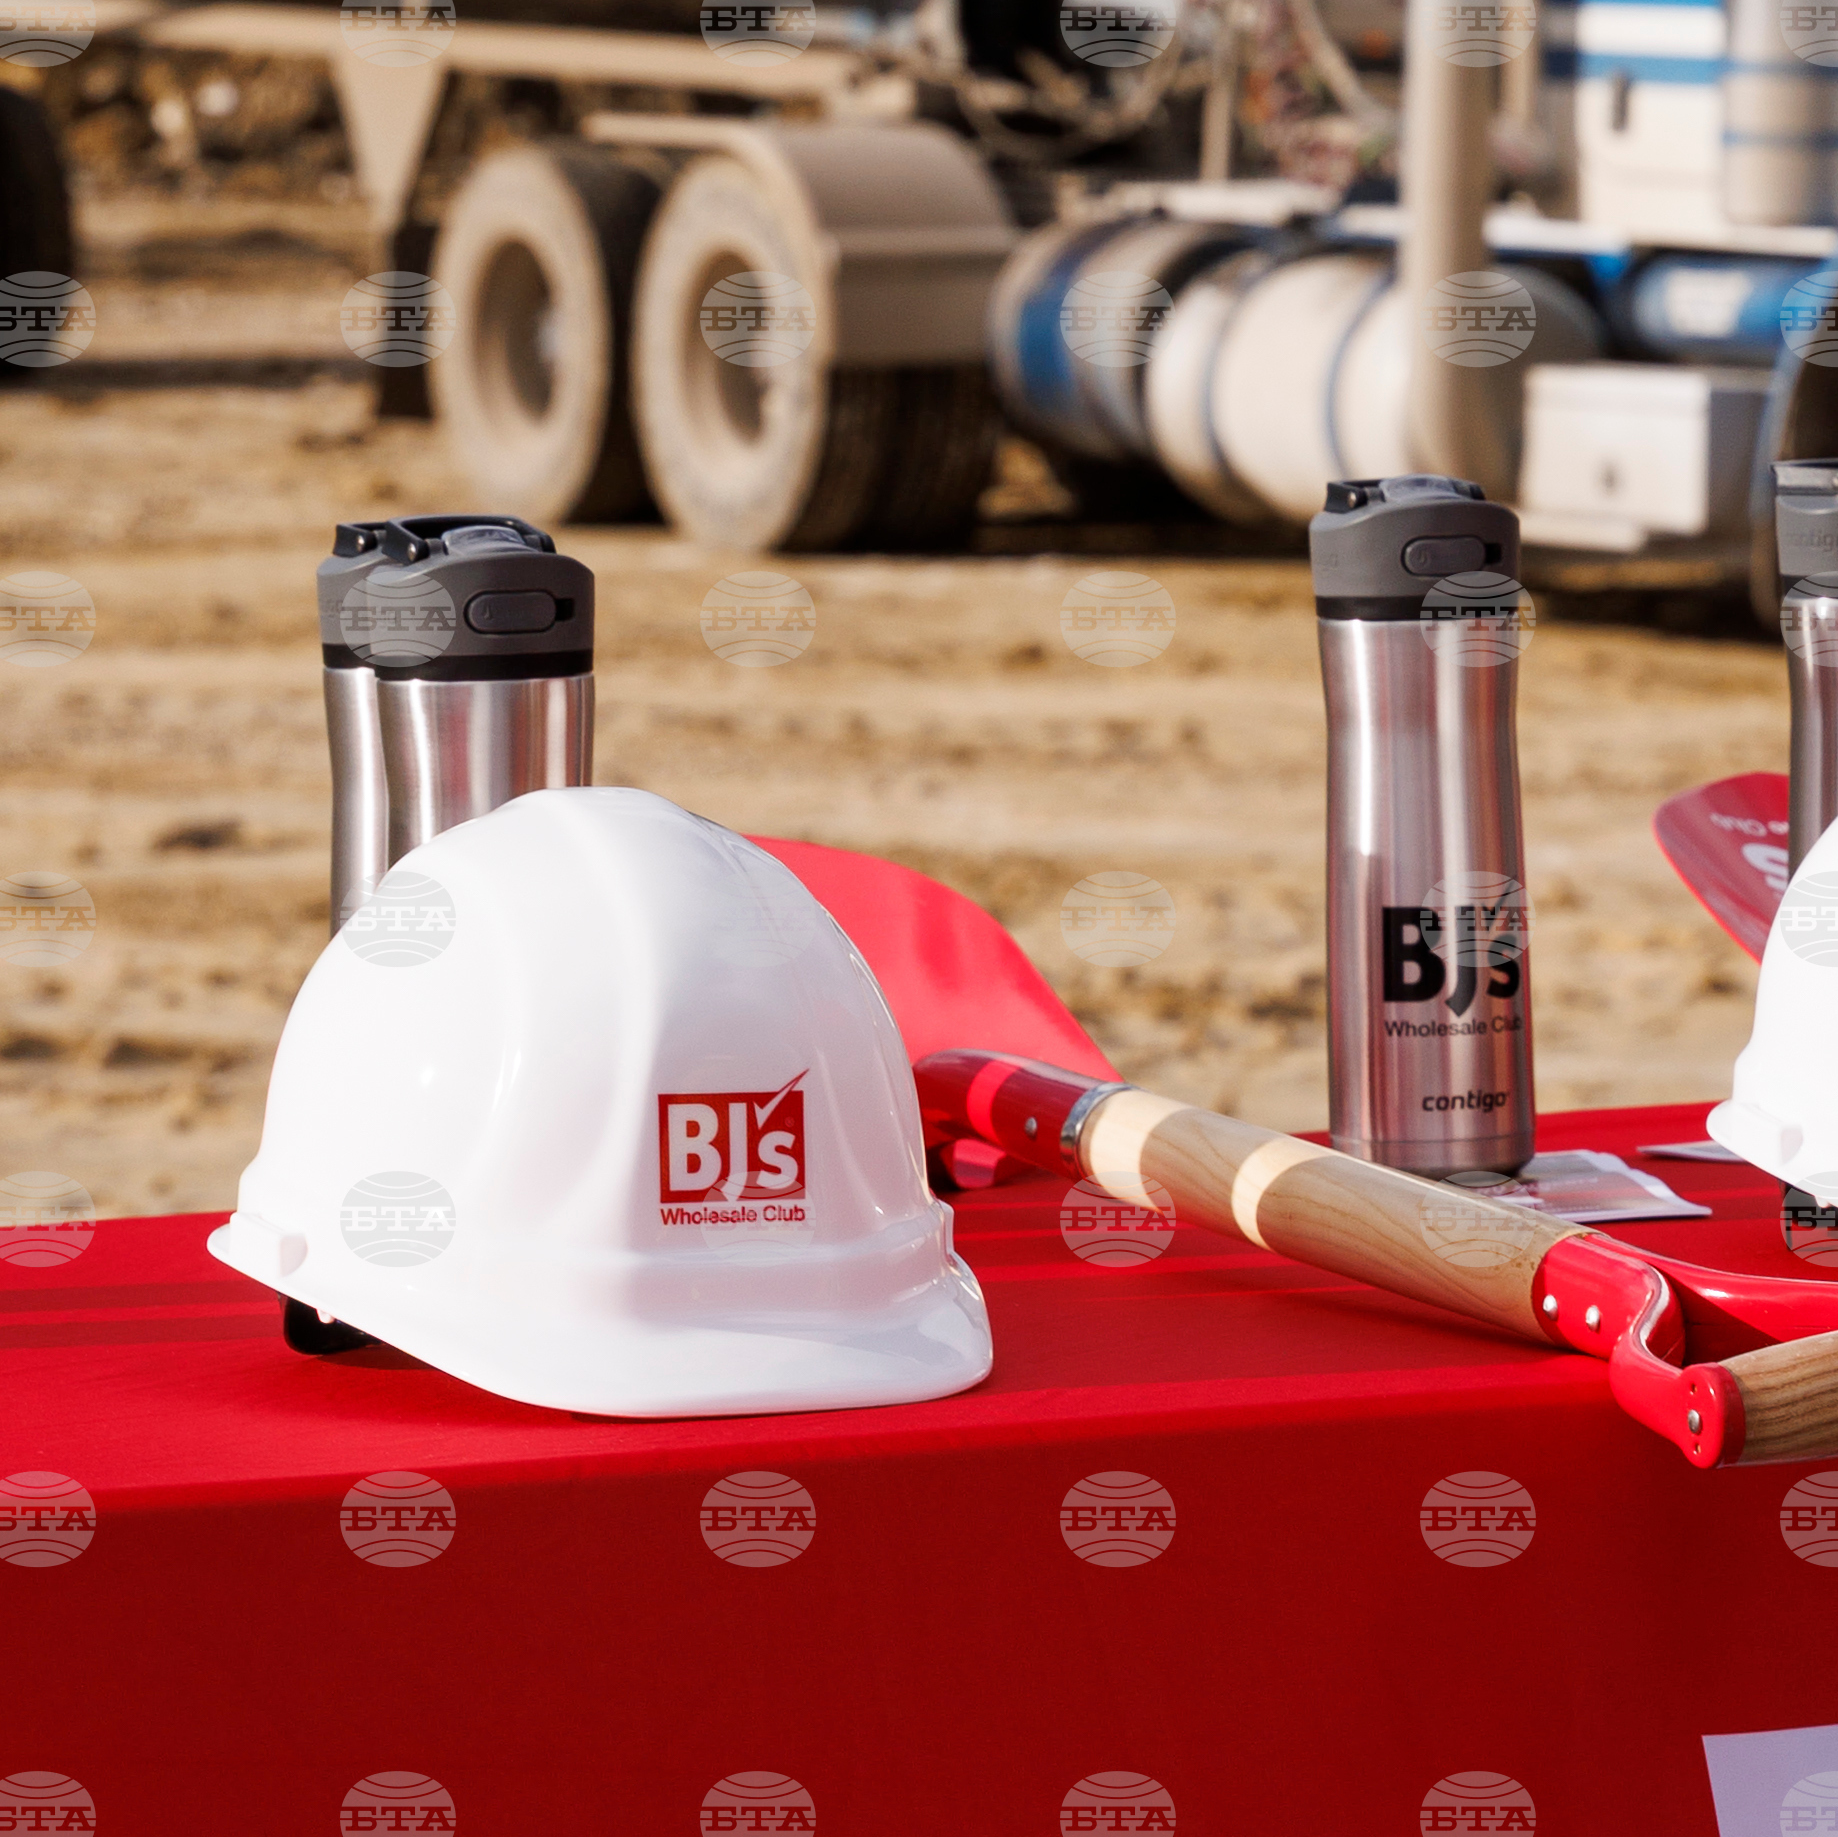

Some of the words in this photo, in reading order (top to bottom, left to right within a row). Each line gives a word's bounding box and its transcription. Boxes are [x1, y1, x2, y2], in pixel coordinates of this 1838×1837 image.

[1385, 1019, 1488, 1038] Wholesale
[1422, 1089, 1507, 1113] contigo
[661, 1206, 757, 1226] Wholesale
[762, 1204, 806, 1224] Club
